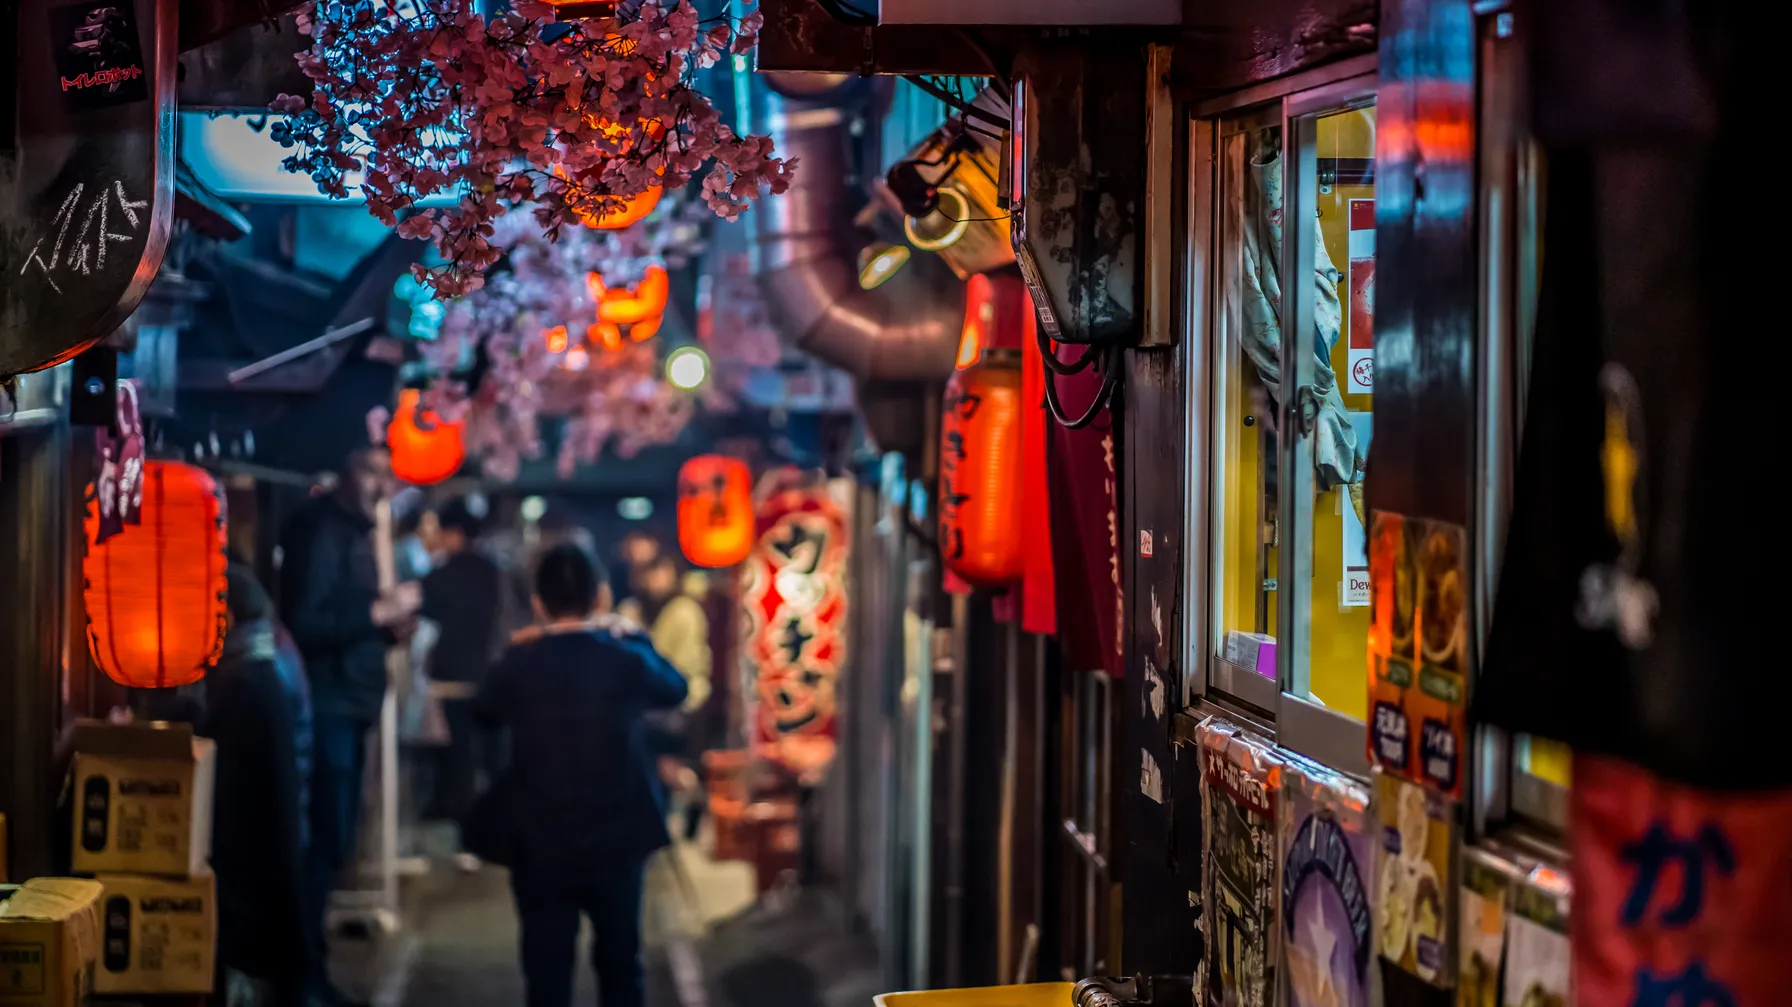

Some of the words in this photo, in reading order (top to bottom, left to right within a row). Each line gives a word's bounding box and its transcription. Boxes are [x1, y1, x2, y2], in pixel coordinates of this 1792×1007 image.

[61, 64, 142, 91] トイレロボット
